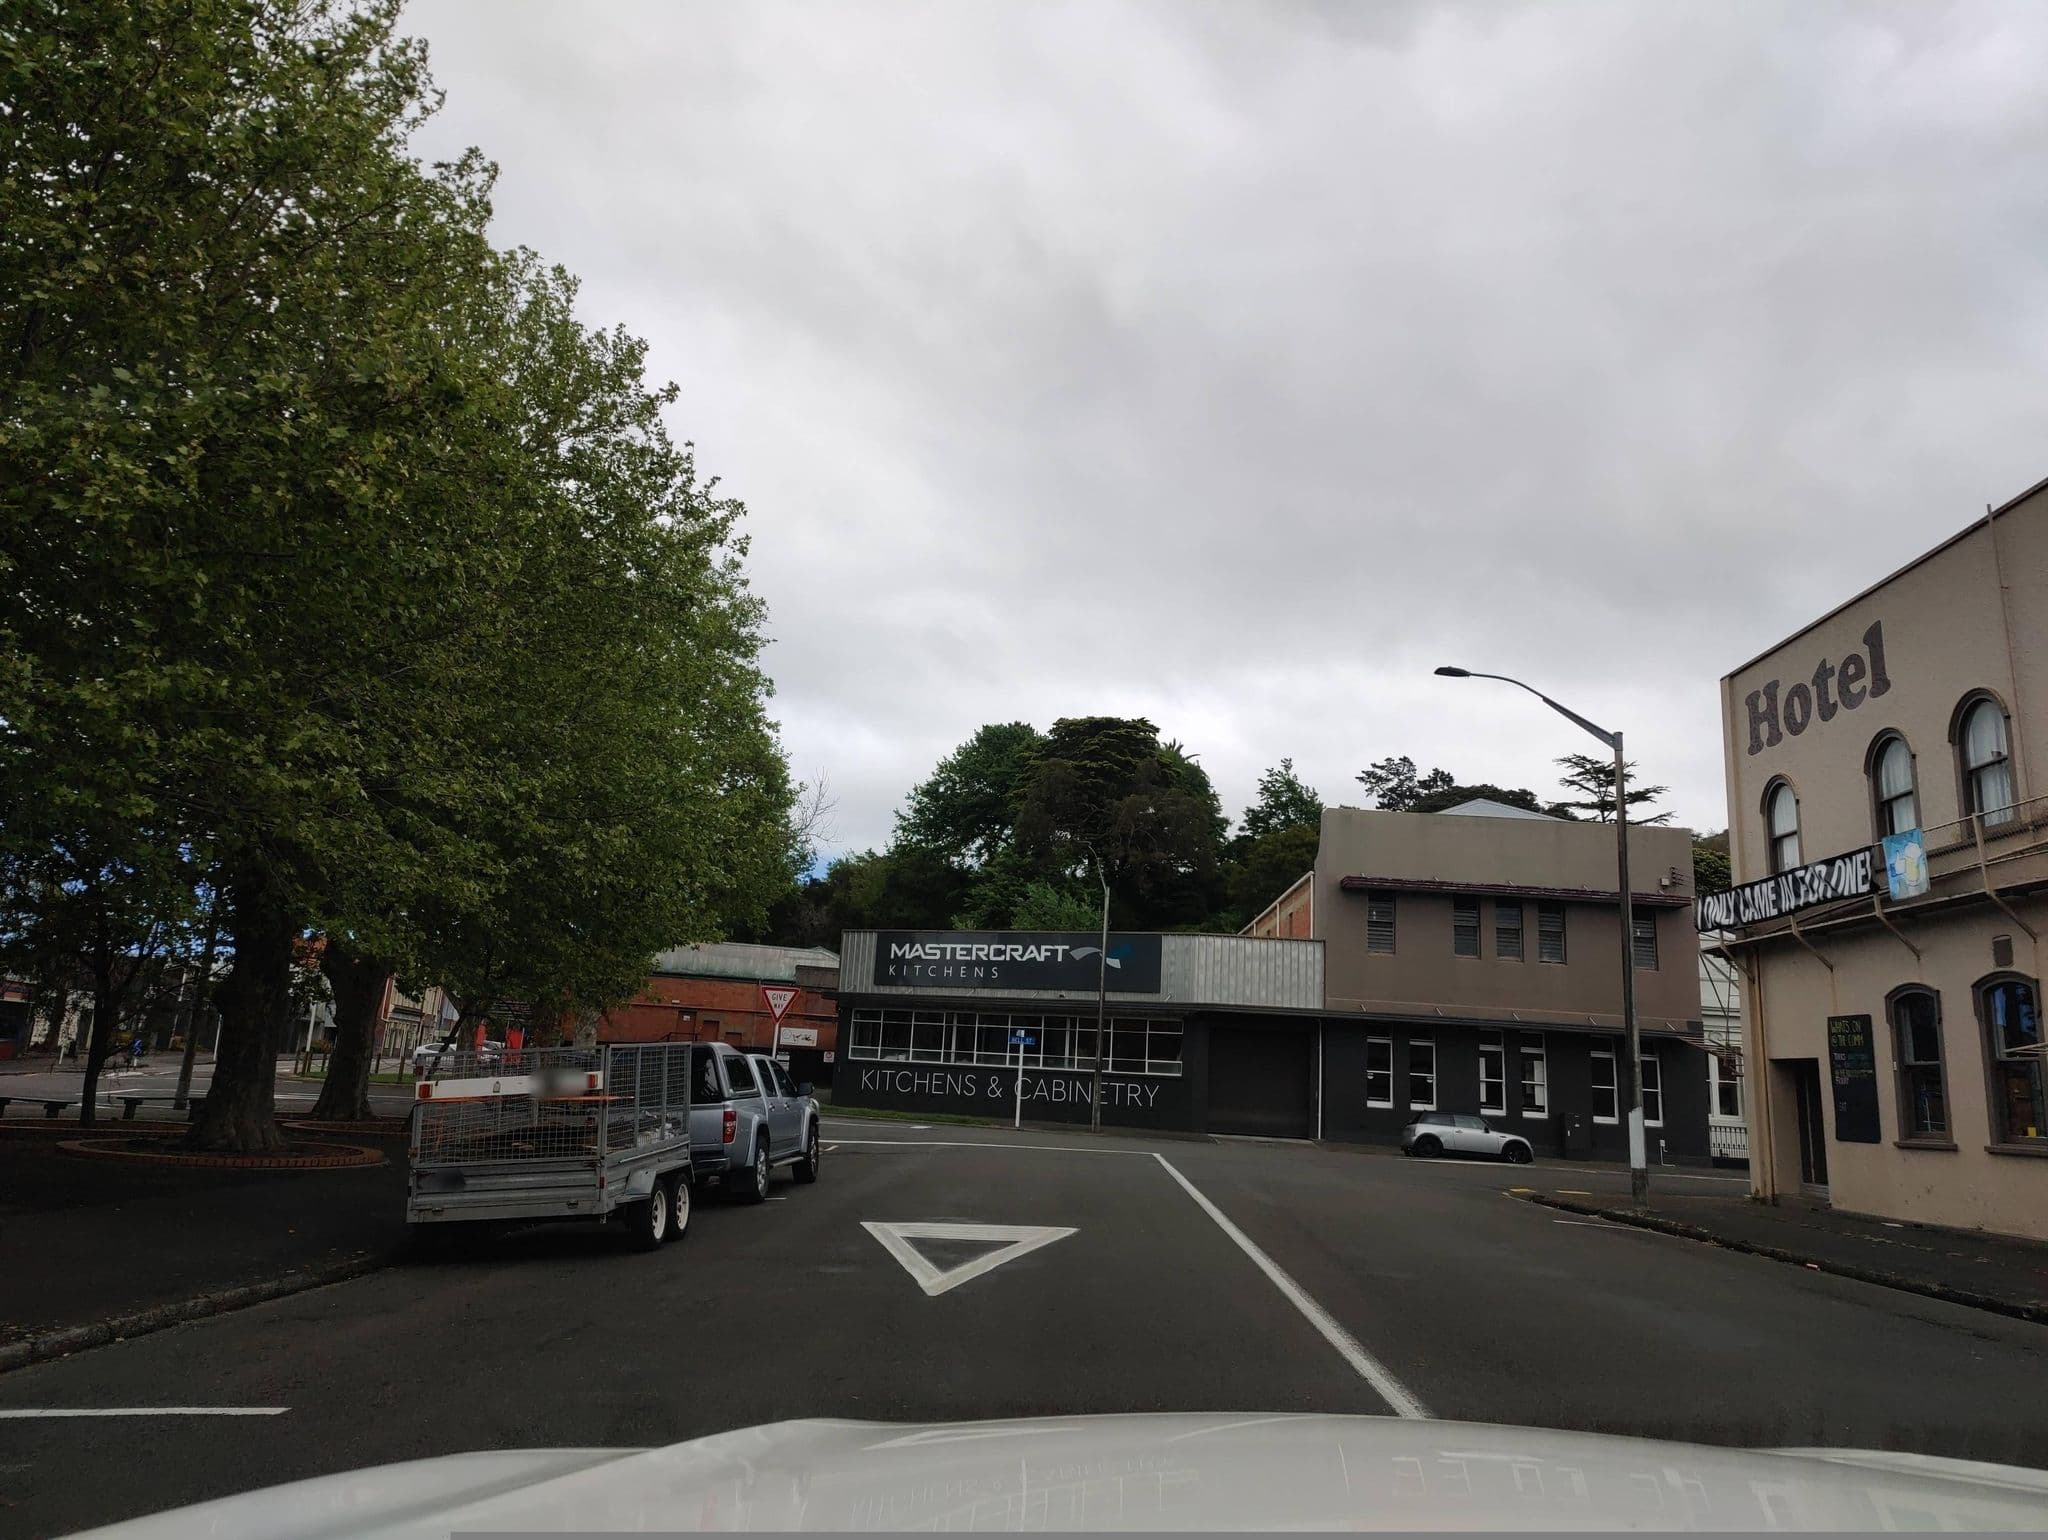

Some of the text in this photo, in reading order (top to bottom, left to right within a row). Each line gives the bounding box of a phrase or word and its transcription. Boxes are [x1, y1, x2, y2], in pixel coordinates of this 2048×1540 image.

[1745, 619, 1892, 757] Hotel
[1697, 899, 1702, 930] I
[1703, 890, 1736, 929] ONLY
[1737, 880, 1779, 923] CAME
[1778, 873, 1796, 913] IN
[1796, 864, 1832, 907] FOR
[890, 943, 1070, 962] MASTERCRAFT
[888, 964, 999, 979] KITCHENS
[772, 993, 788, 1002] GIVE
[861, 1069, 1160, 1108] KITCHENS & CABINETRY
